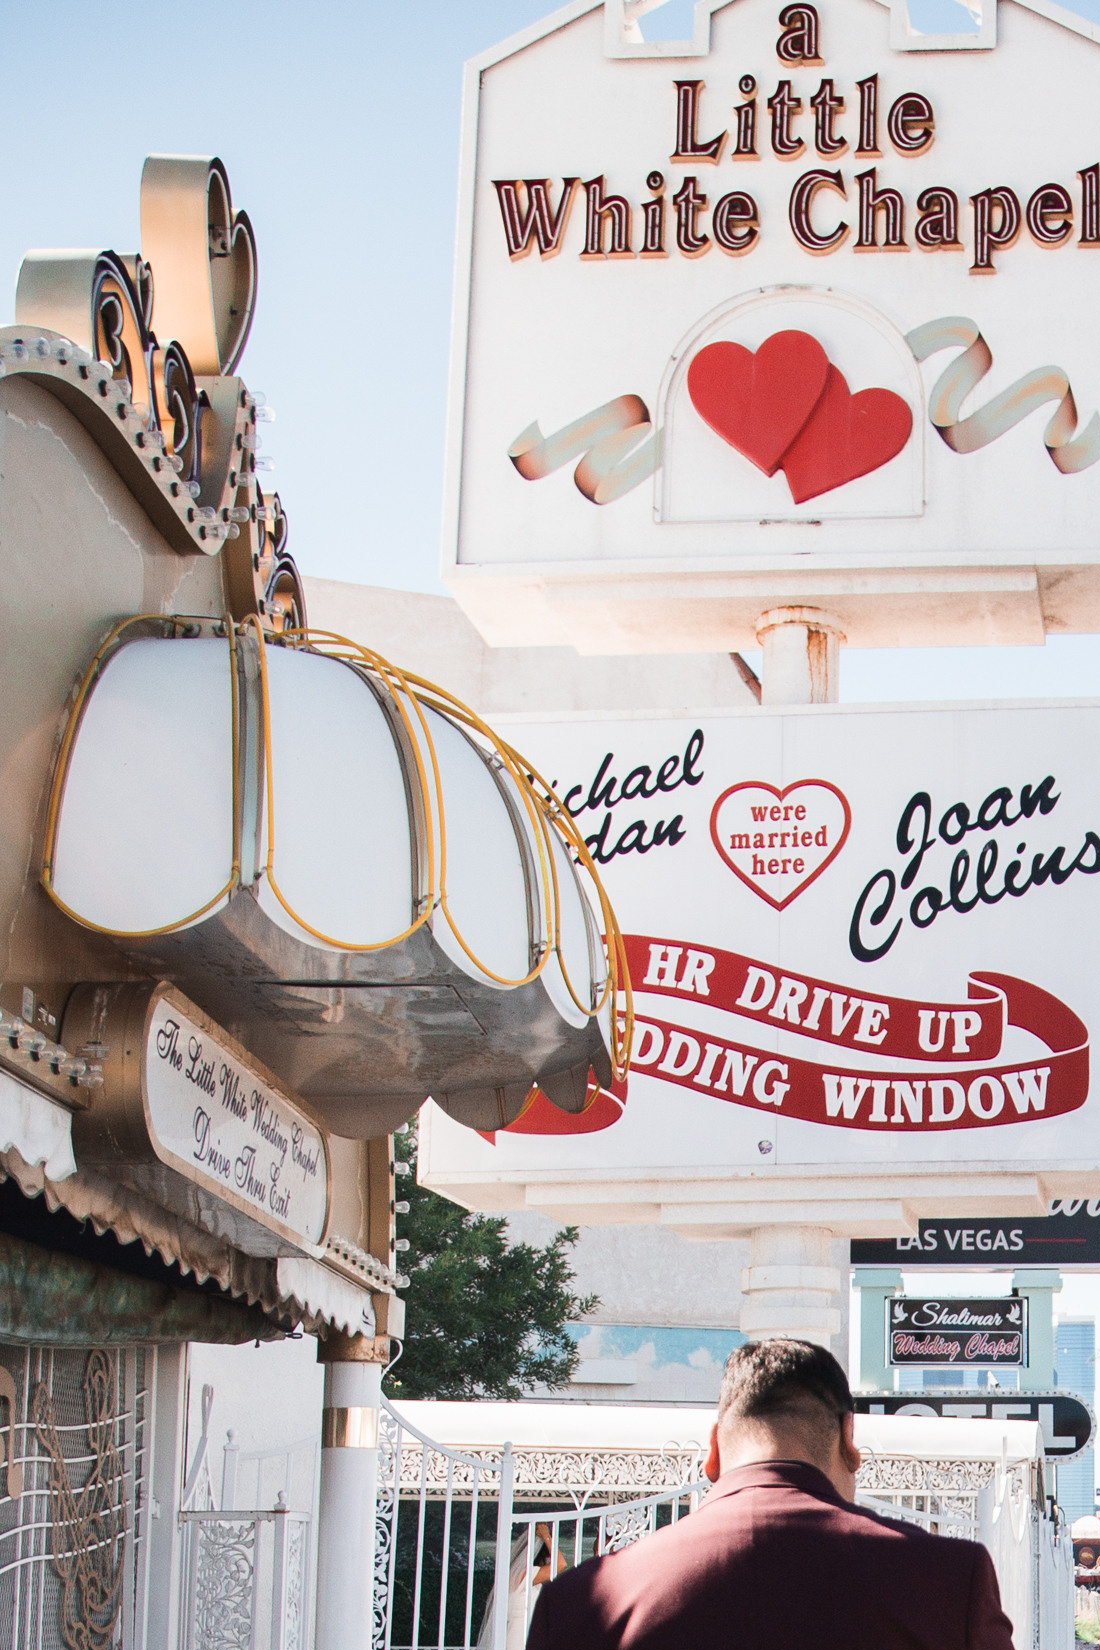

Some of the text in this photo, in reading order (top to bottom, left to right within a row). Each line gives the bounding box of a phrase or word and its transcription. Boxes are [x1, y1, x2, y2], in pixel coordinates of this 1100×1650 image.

[776, 3, 825, 67] a
[670, 73, 935, 165] Little
[492, 170, 760, 262] White
[564, 812, 686, 866] dan
[730, 825, 828, 849] married
[751, 804, 806, 821] were
[896, 775, 1061, 890] Joan
[751, 853, 805, 875] here
[643, 943, 716, 996] HR
[736, 965, 890, 1045] DRIVE
[918, 1009, 982, 1053] UP
[157, 1019, 320, 1182] The Little White Wedding Chapel
[617, 1017, 1051, 1123] DDING WINDOW
[193, 1106, 291, 1219] Drive Thru Exit
[896, 1229, 1024, 1250] LAS VEGAS
[911, 1302, 1003, 1326] Shalimar
[894, 1332, 1018, 1361] Wedding Chapel
